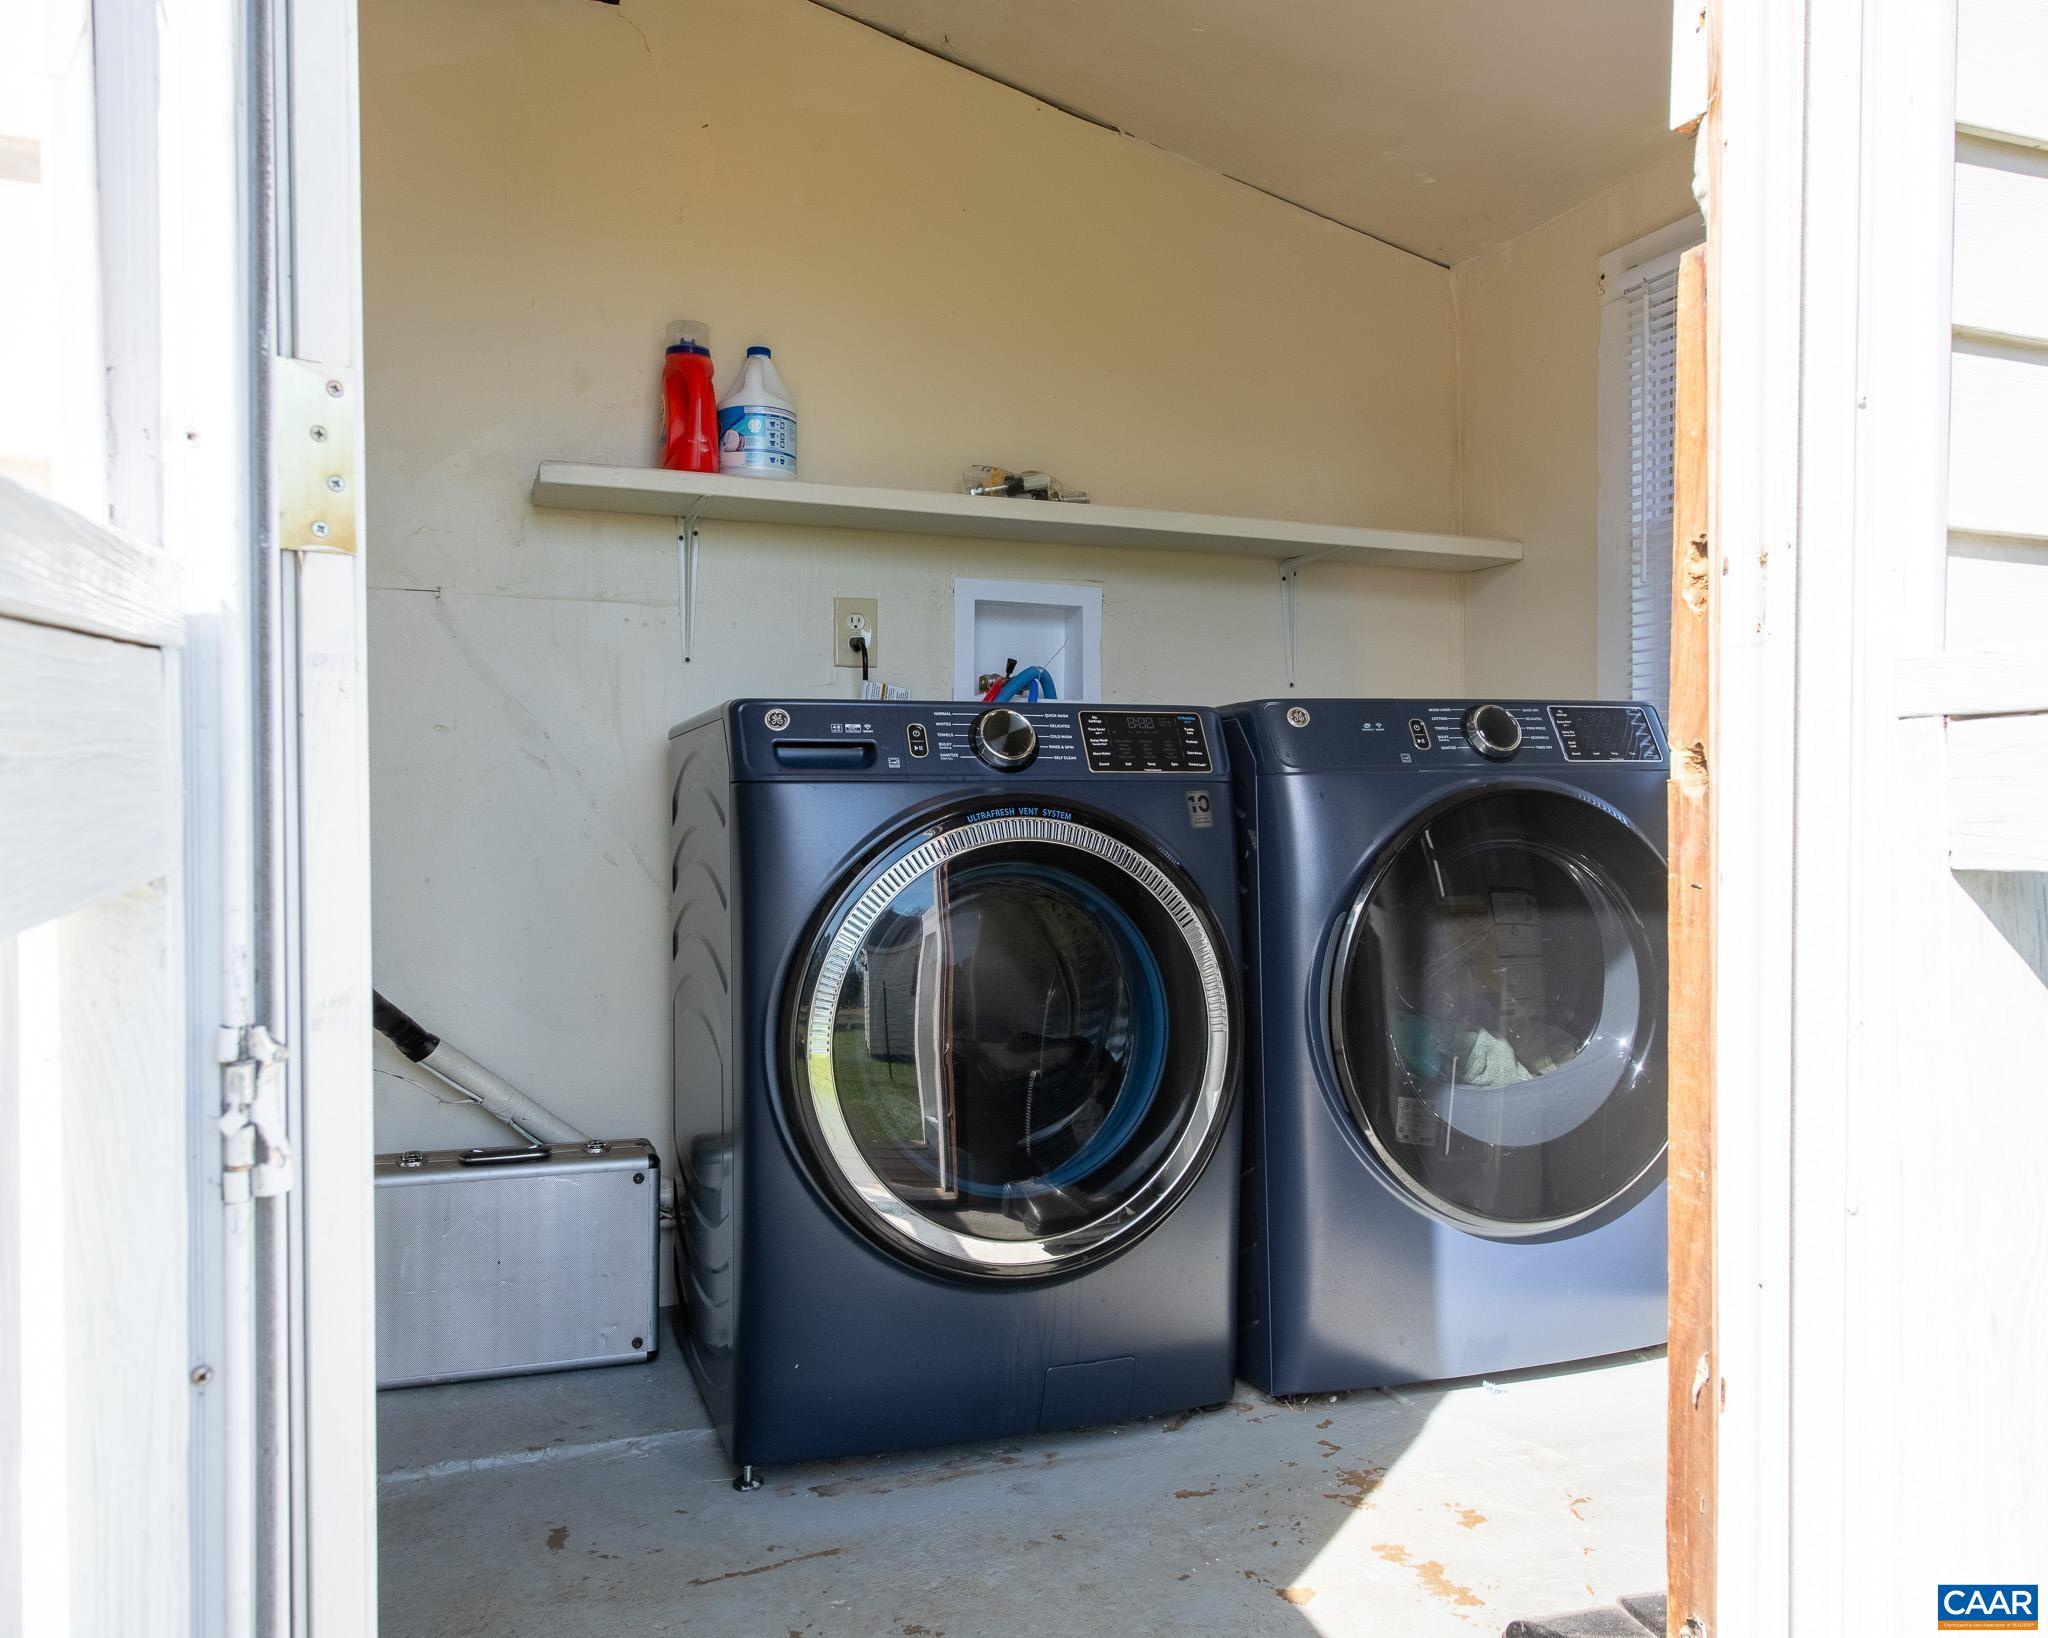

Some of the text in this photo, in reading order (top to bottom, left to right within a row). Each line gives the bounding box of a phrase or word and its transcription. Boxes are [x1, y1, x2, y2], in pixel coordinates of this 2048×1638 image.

[966, 807, 1072, 823] ULTRAFRESH VENT SYSTEM
